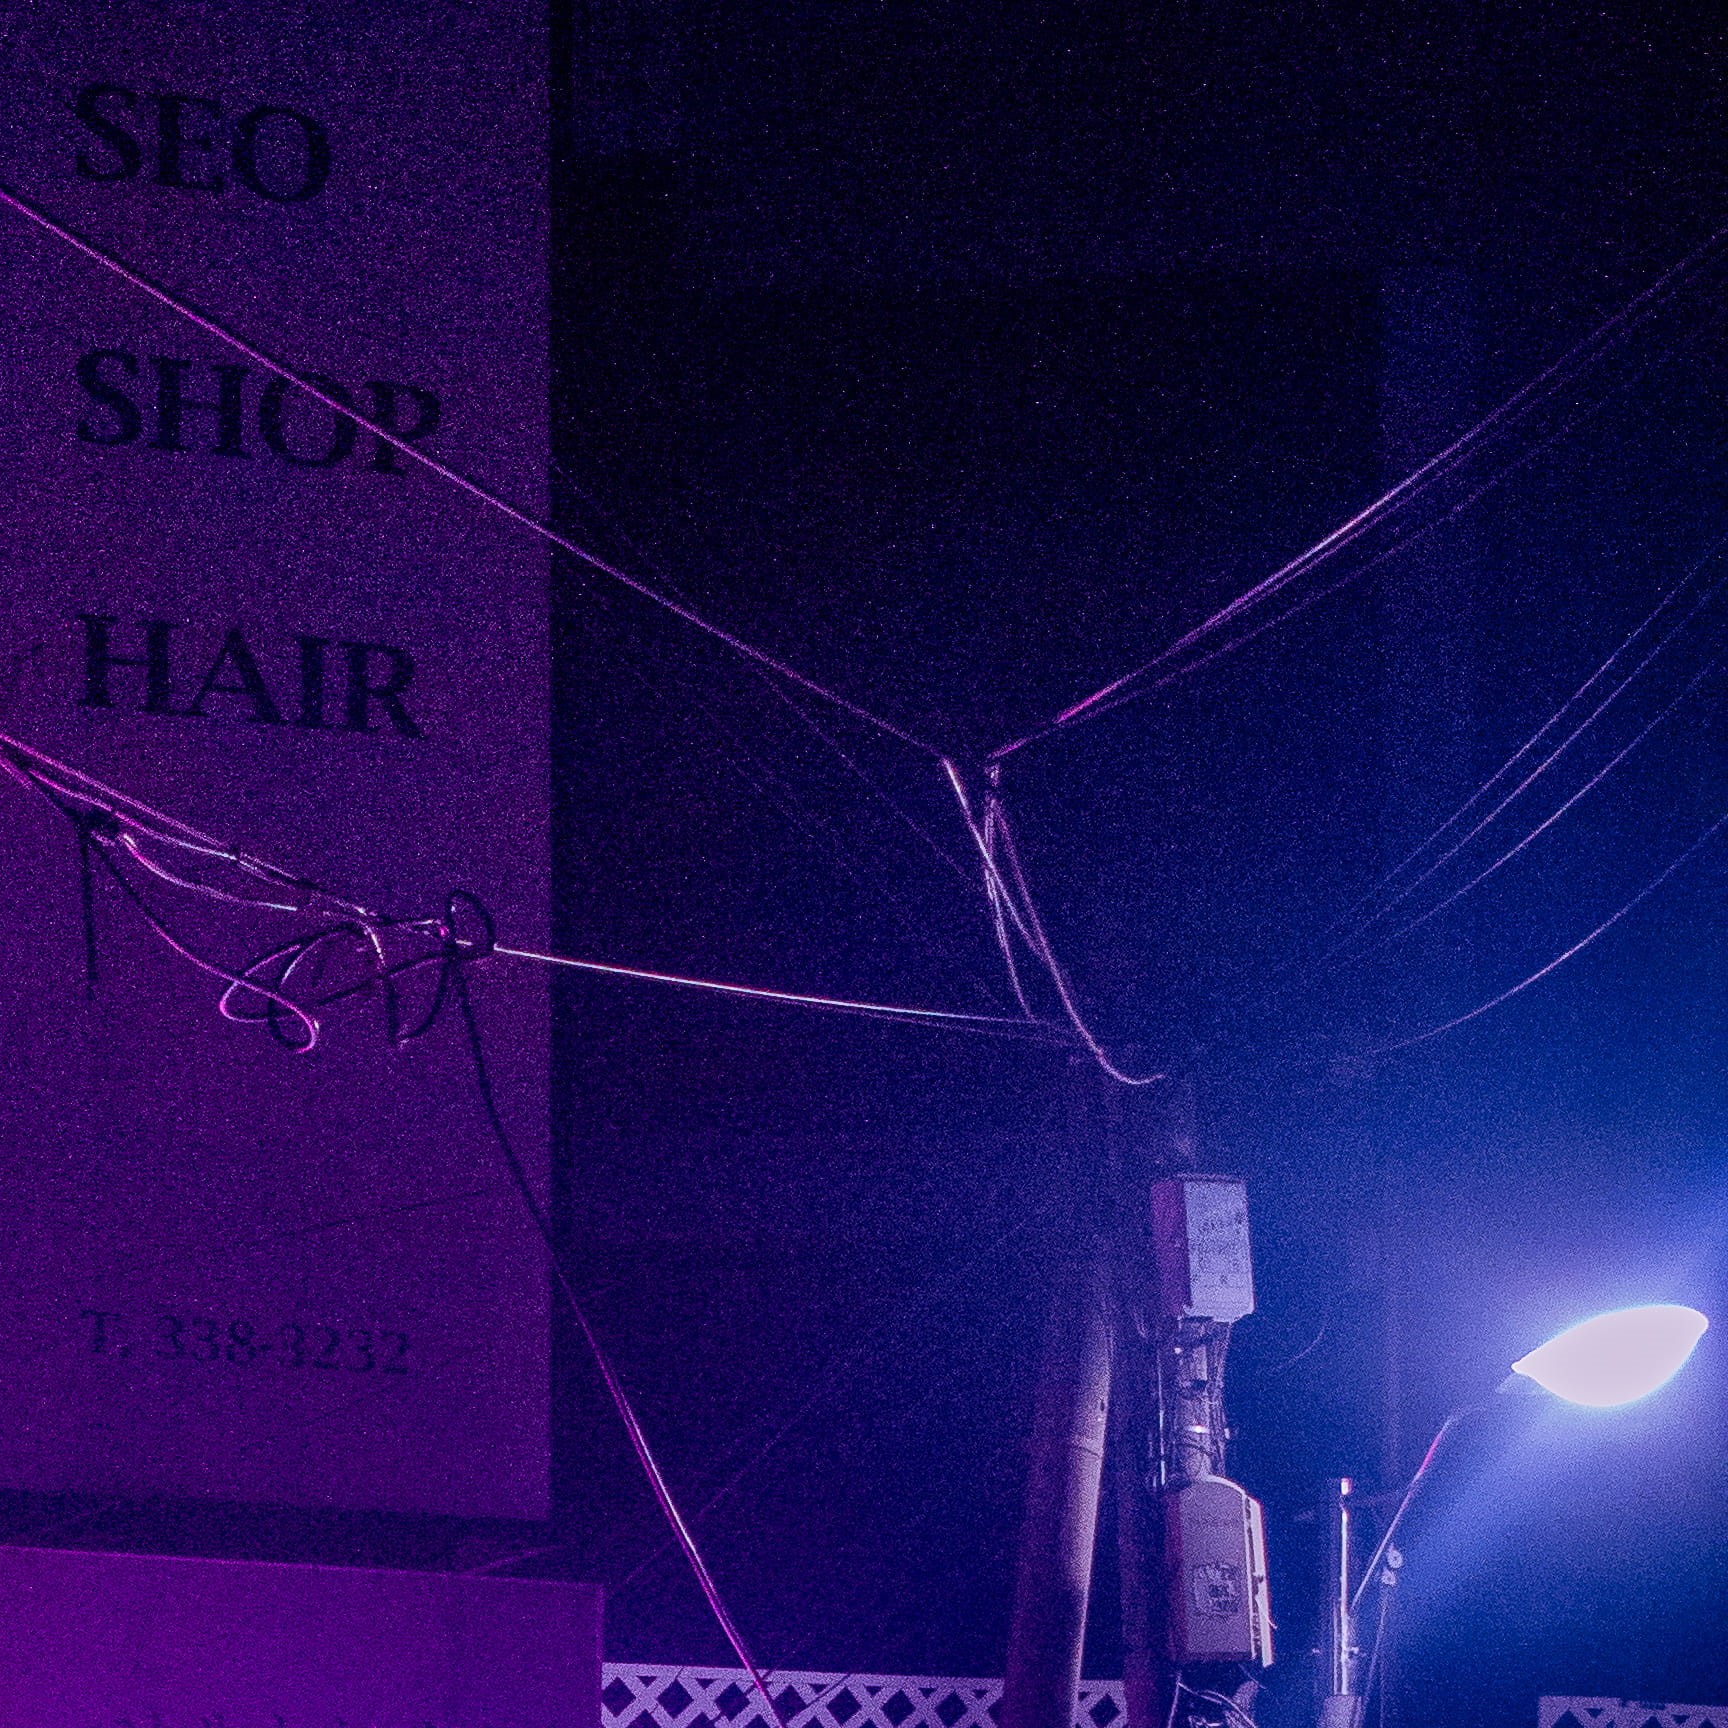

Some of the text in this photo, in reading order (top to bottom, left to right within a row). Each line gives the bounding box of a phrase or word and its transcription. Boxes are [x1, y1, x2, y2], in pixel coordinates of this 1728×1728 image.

[72, 80, 331, 205] SEO
[74, 346, 443, 478] SHOP
[74, 611, 425, 741] HAIR
